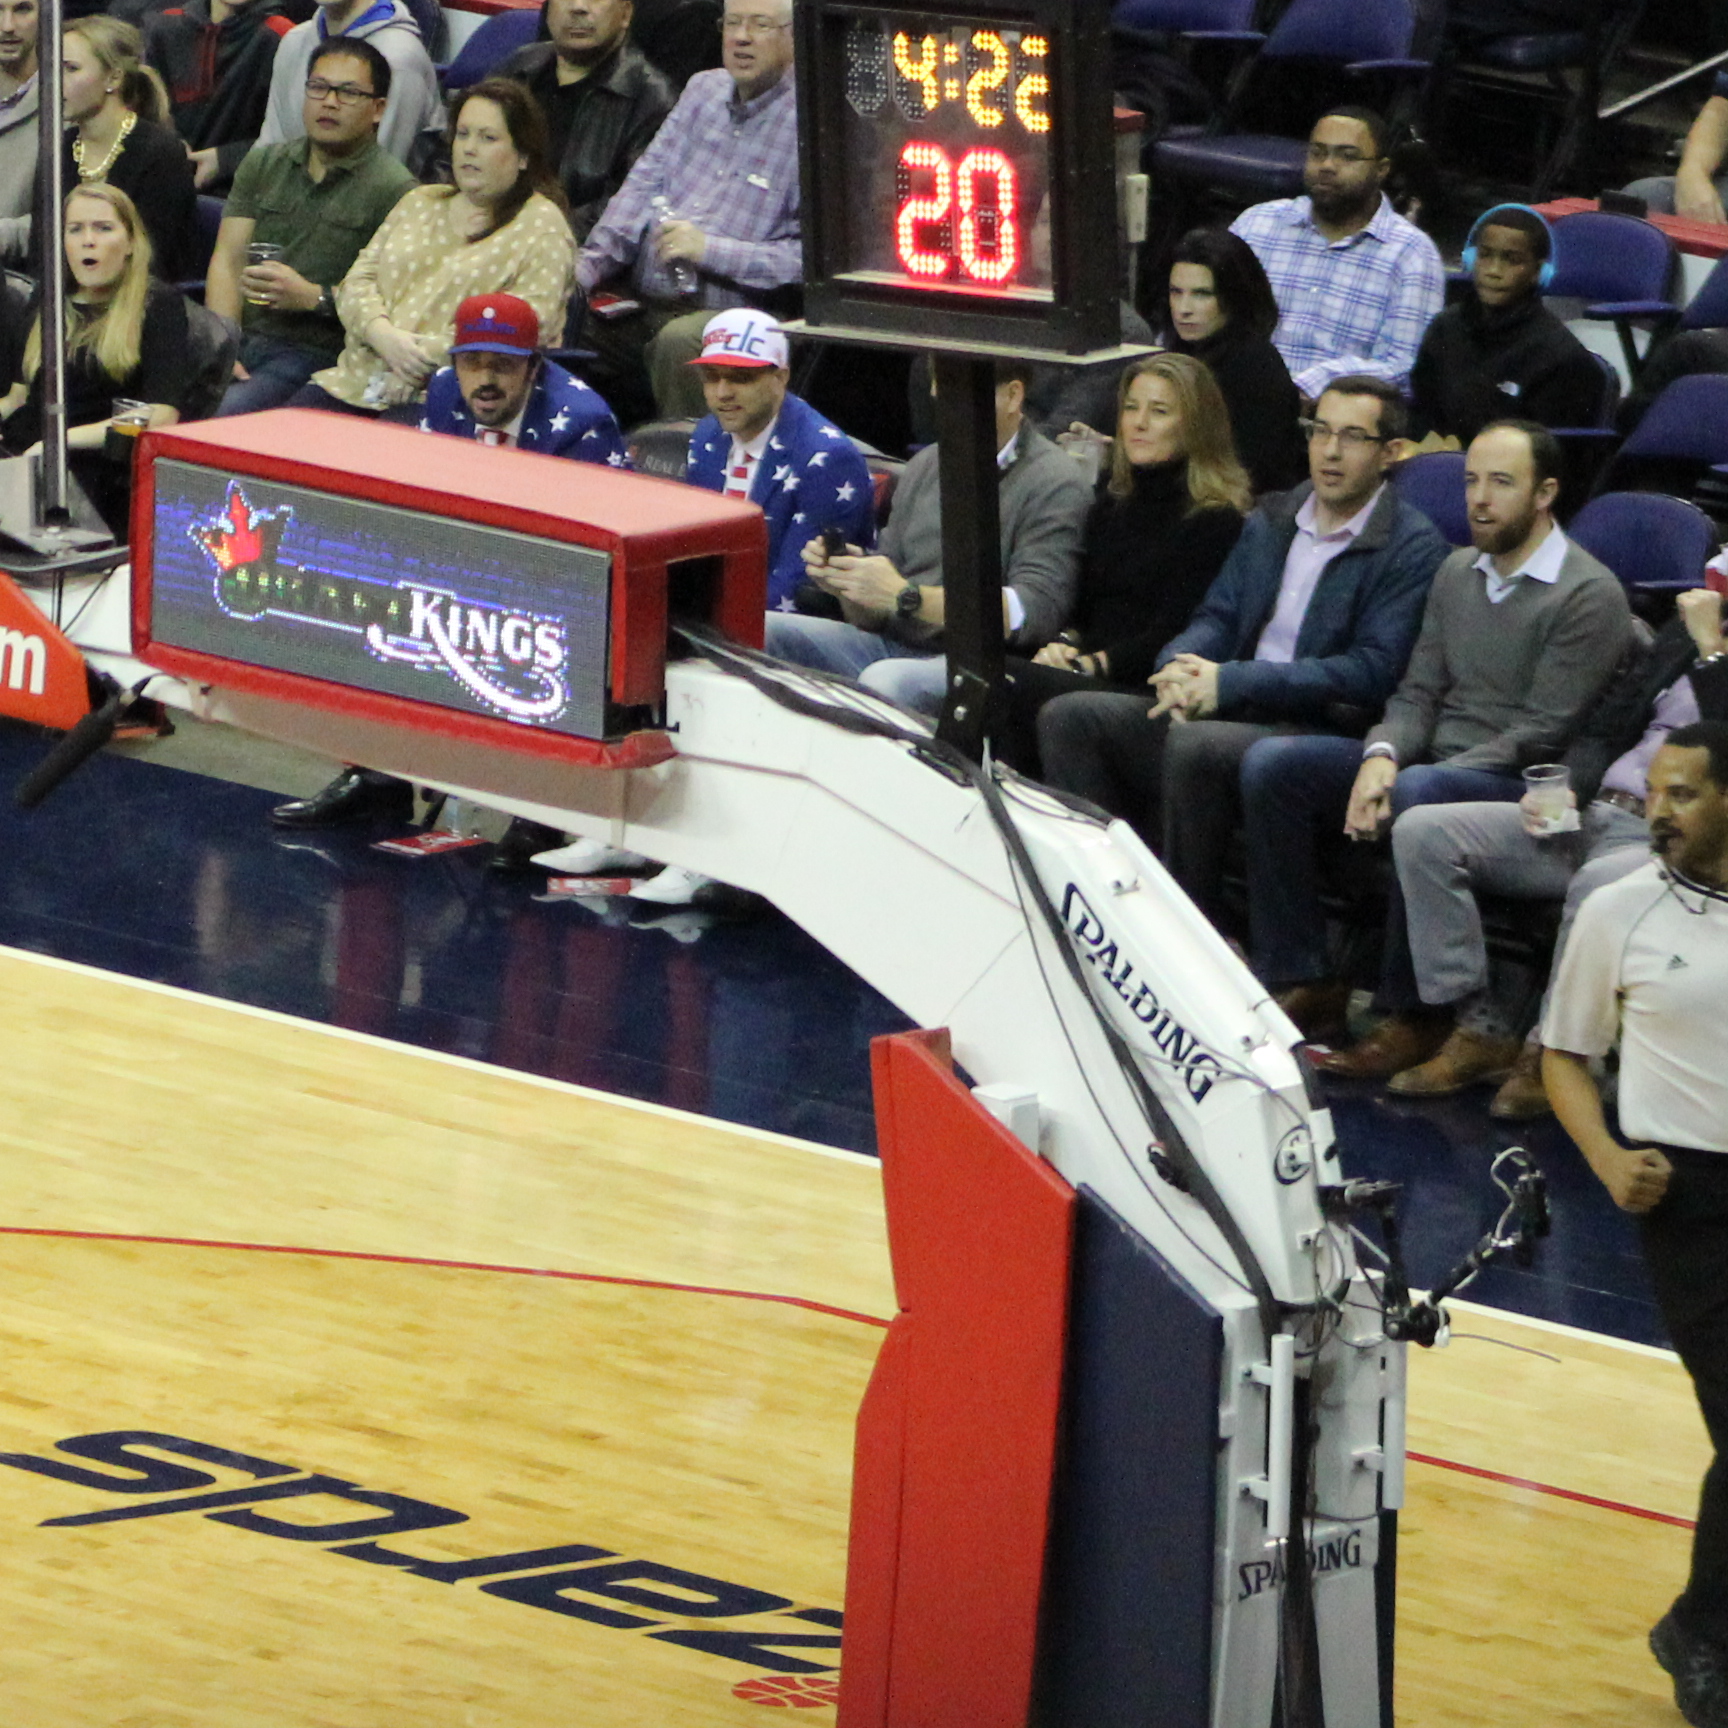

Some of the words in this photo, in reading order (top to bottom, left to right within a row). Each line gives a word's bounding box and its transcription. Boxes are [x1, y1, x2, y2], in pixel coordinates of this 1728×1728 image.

[893, 30, 1052, 133] 4:22
[897, 141, 1017, 283] 20
[408, 589, 566, 671] KINGS
[1060, 881, 1230, 1106] SPALDING
[1237, 1529, 1362, 1604] SPADING
